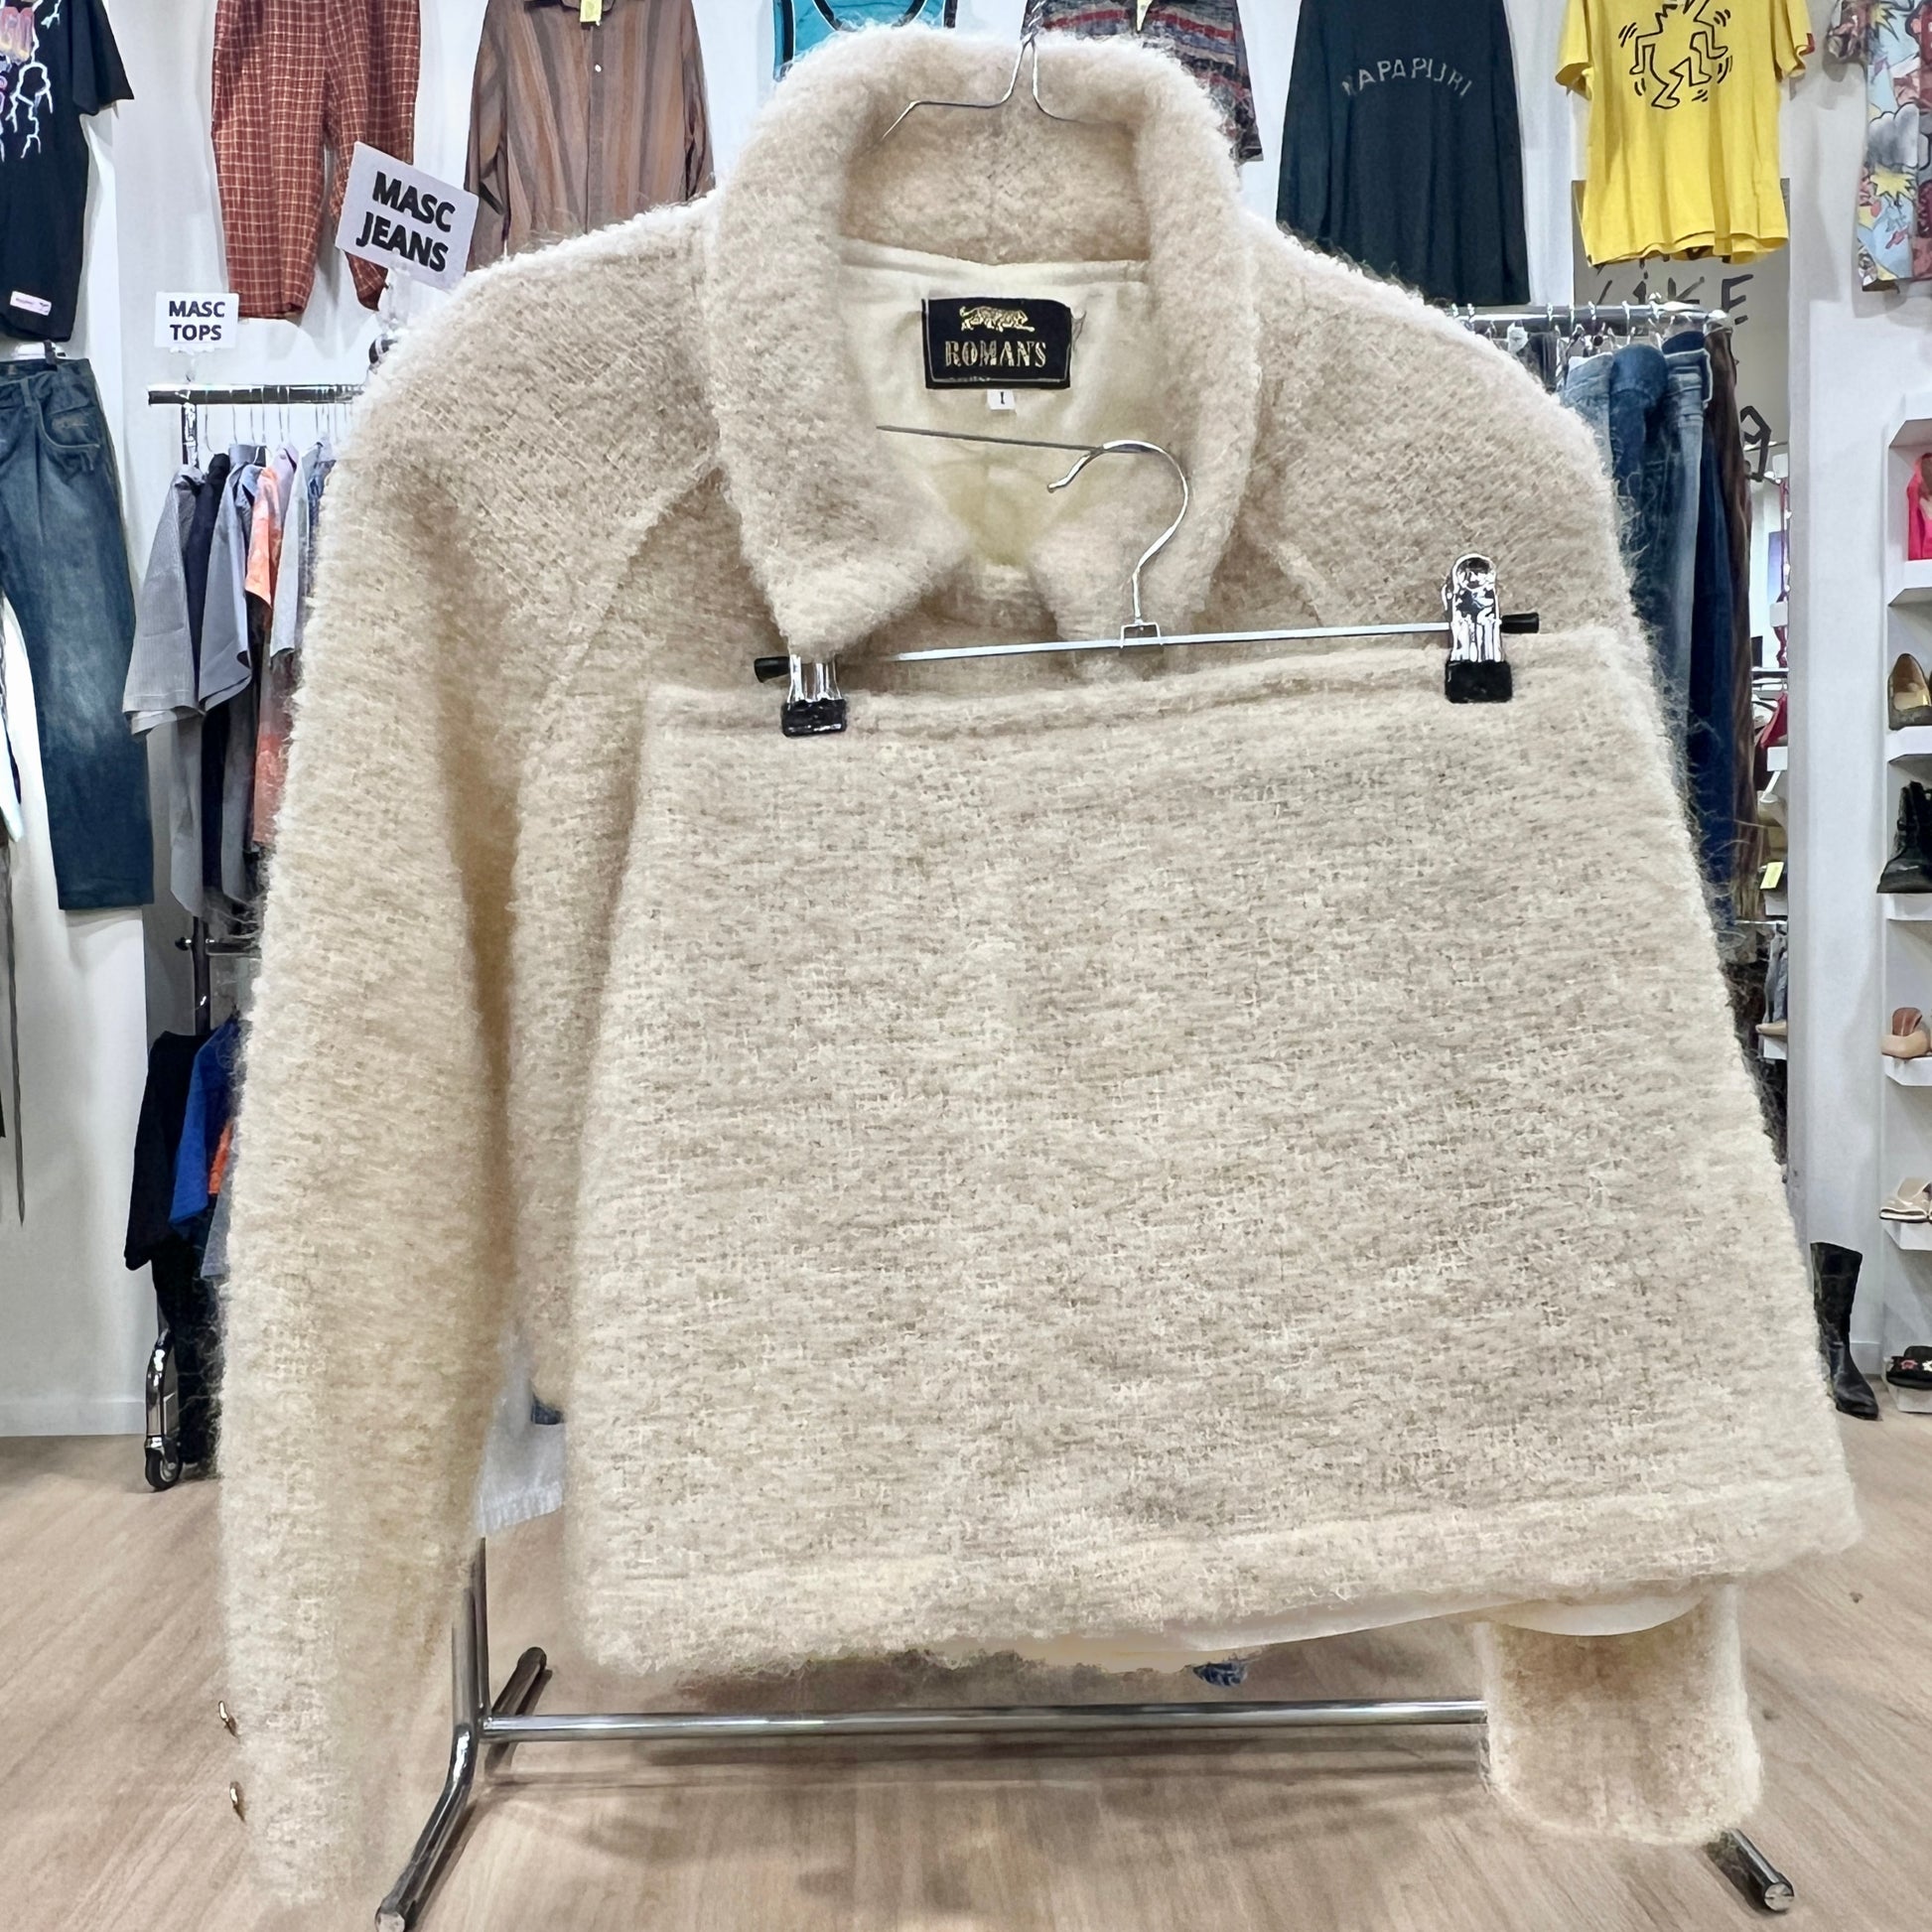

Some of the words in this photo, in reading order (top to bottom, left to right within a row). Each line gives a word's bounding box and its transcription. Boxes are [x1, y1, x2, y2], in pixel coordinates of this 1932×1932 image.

[372, 171, 456, 232] MASC
[355, 211, 449, 272] JEANS
[169, 300, 225, 318] MASC
[169, 324, 221, 341] TOPS
